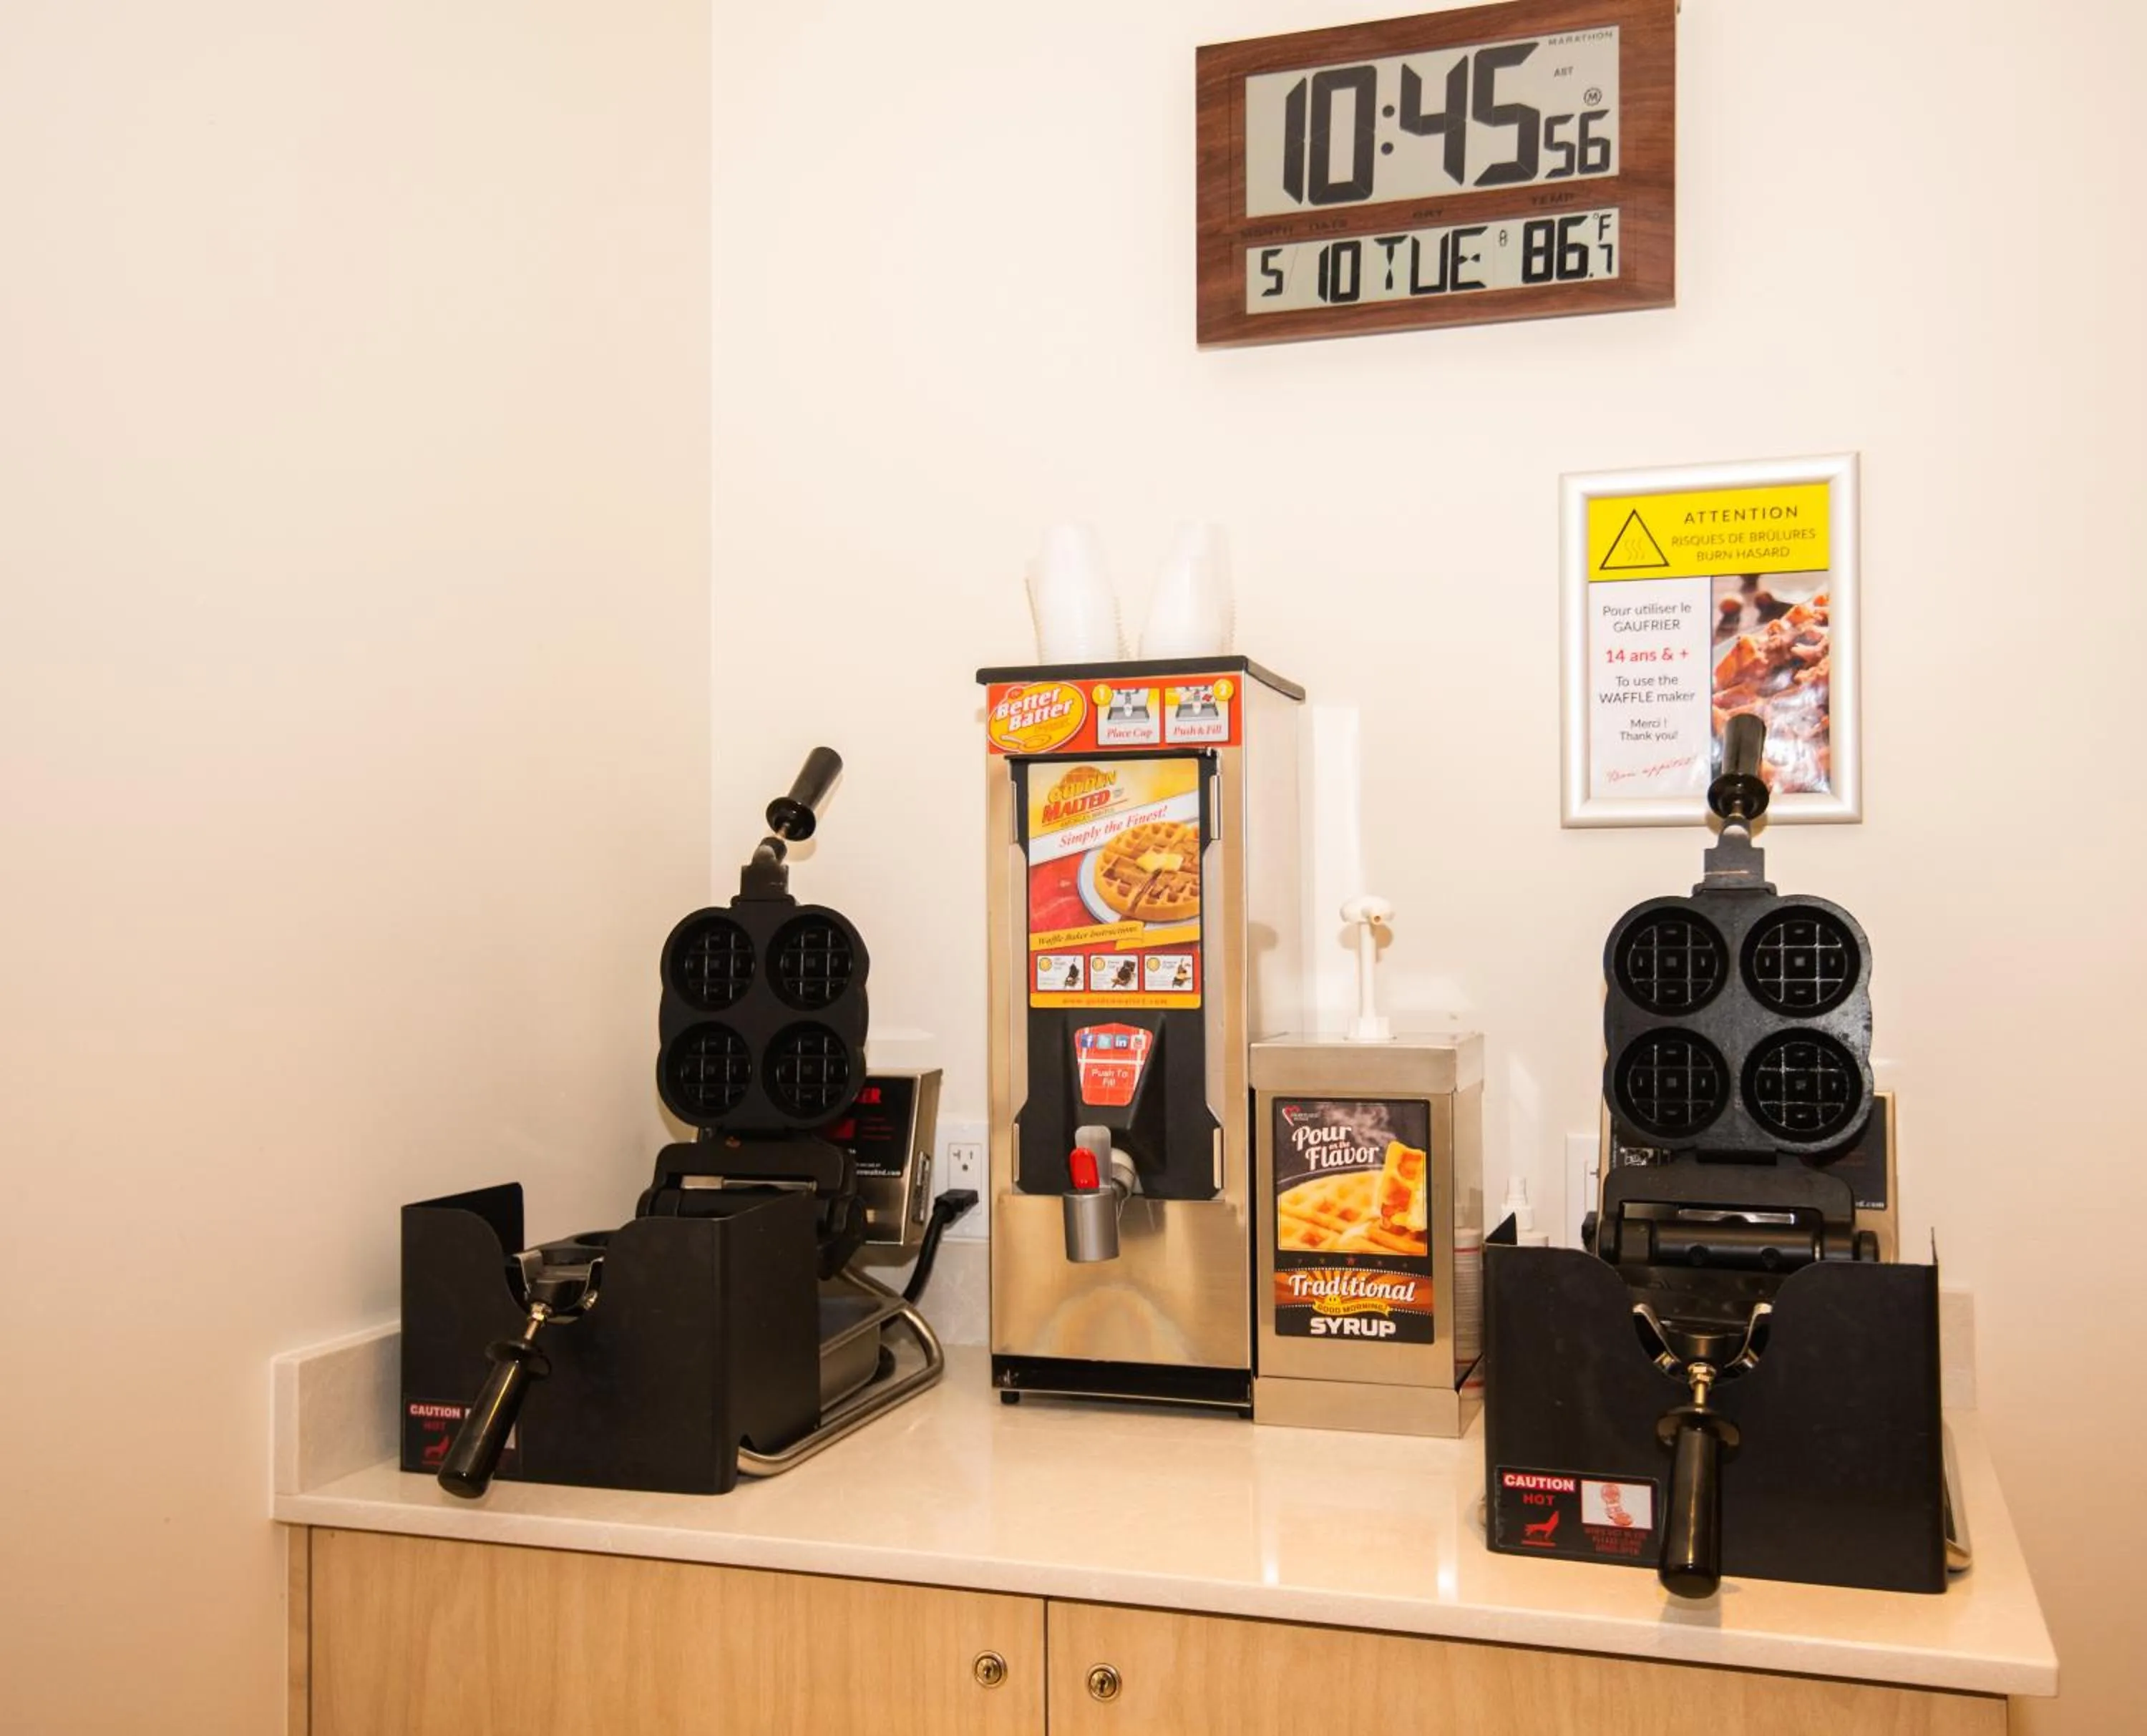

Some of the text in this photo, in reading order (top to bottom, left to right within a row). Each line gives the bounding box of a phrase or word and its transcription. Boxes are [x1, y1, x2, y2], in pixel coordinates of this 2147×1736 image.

[1548, 31, 1612, 45] MARATHON
[1283, 42, 1611, 206] 10:45 56
[1373, 225, 1489, 296] TUE
[1684, 505, 1798, 525] ATTENTION
[1671, 534, 1725, 547] RISQUES
[1728, 532, 1746, 544] DE
[1697, 546, 1791, 562] BURN HASARD
[1602, 602, 1692, 617] Pour utiliser le
[1613, 619, 1681, 633] GAUFRIER
[1606, 649, 1625, 663] 14
[1630, 650, 1657, 662] ans
[1661, 647, 1674, 661] &
[1615, 675, 1678, 688] To use the
[995, 687, 1062, 721] Better
[1599, 691, 1695, 703] WAFFLE maker
[1009, 699, 1074, 732] Batter
[1173, 726, 1196, 736] Push
[1205, 725, 1222, 734] Fill
[1630, 718, 1661, 729] Merci
[1107, 726, 1131, 738] Place
[1133, 728, 1153, 738] Cup
[1620, 731, 1653, 741] Thank
[1042, 789, 1111, 823] MALTED
[1059, 826, 1101, 848] Simply
[1105, 820, 1123, 834] the
[1126, 805, 1169, 828] Finest!
[1091, 1068, 1115, 1077] Push
[1292, 1126, 1352, 1151] Pour
[1305, 1145, 1380, 1171] Flavor
[1288, 1274, 1416, 1302] Traditional
[1310, 1316, 1396, 1337] SYRUP
[409, 1404, 462, 1419] CAUTION
[424, 1420, 447, 1431] HOT
[1504, 1474, 1574, 1492] CAUTION
[1522, 1493, 1556, 1506] HOT
